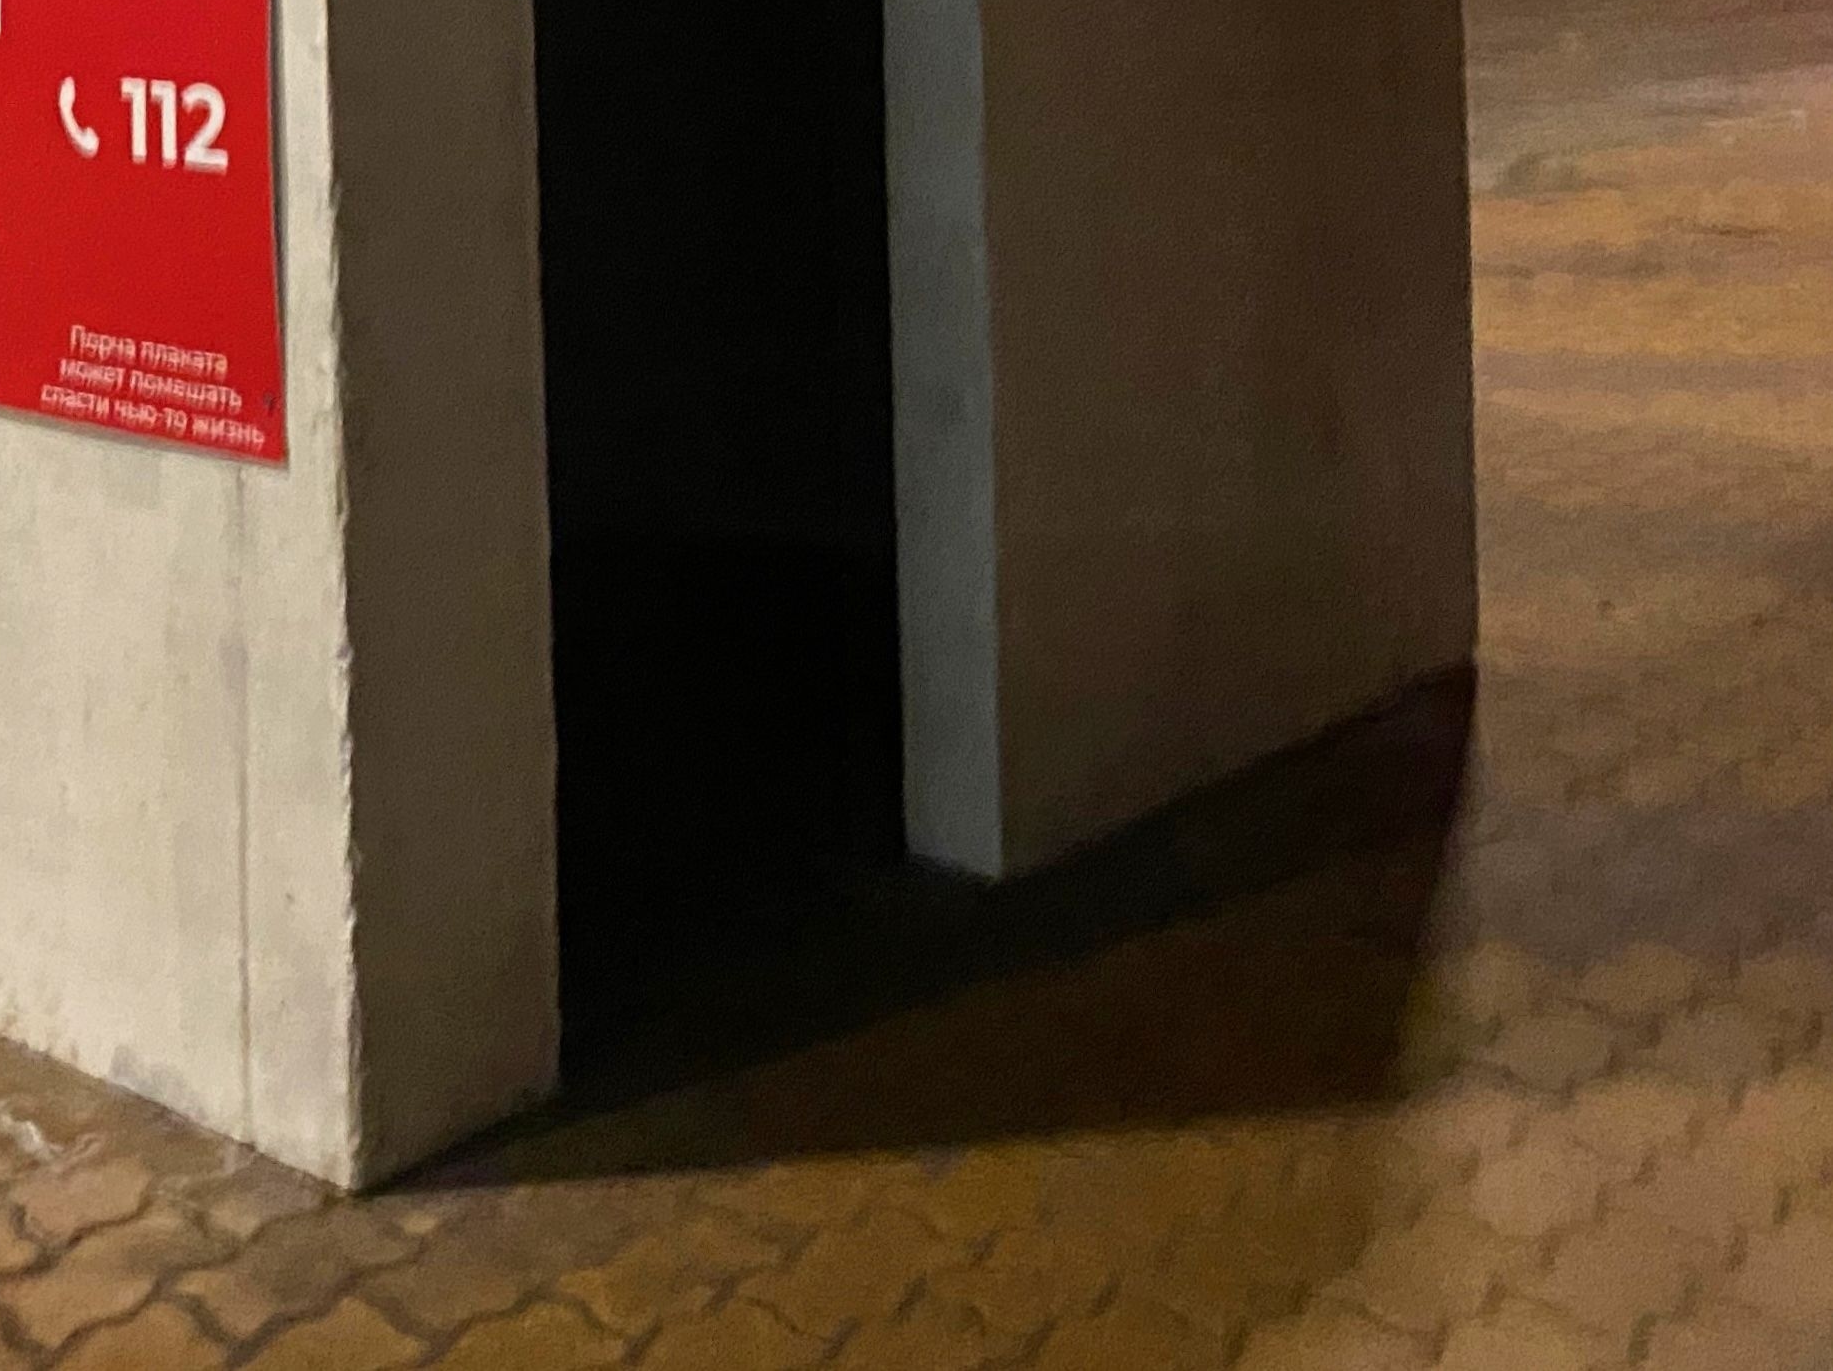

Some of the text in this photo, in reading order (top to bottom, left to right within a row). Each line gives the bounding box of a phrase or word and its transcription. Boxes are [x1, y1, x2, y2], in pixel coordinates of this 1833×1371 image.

[120, 76, 229, 173] 112
[70, 324, 228, 381] Порча плаката
[59, 358, 242, 414] может помешать
[40, 384, 110, 421] спасти
[191, 413, 266, 452] жизнь
